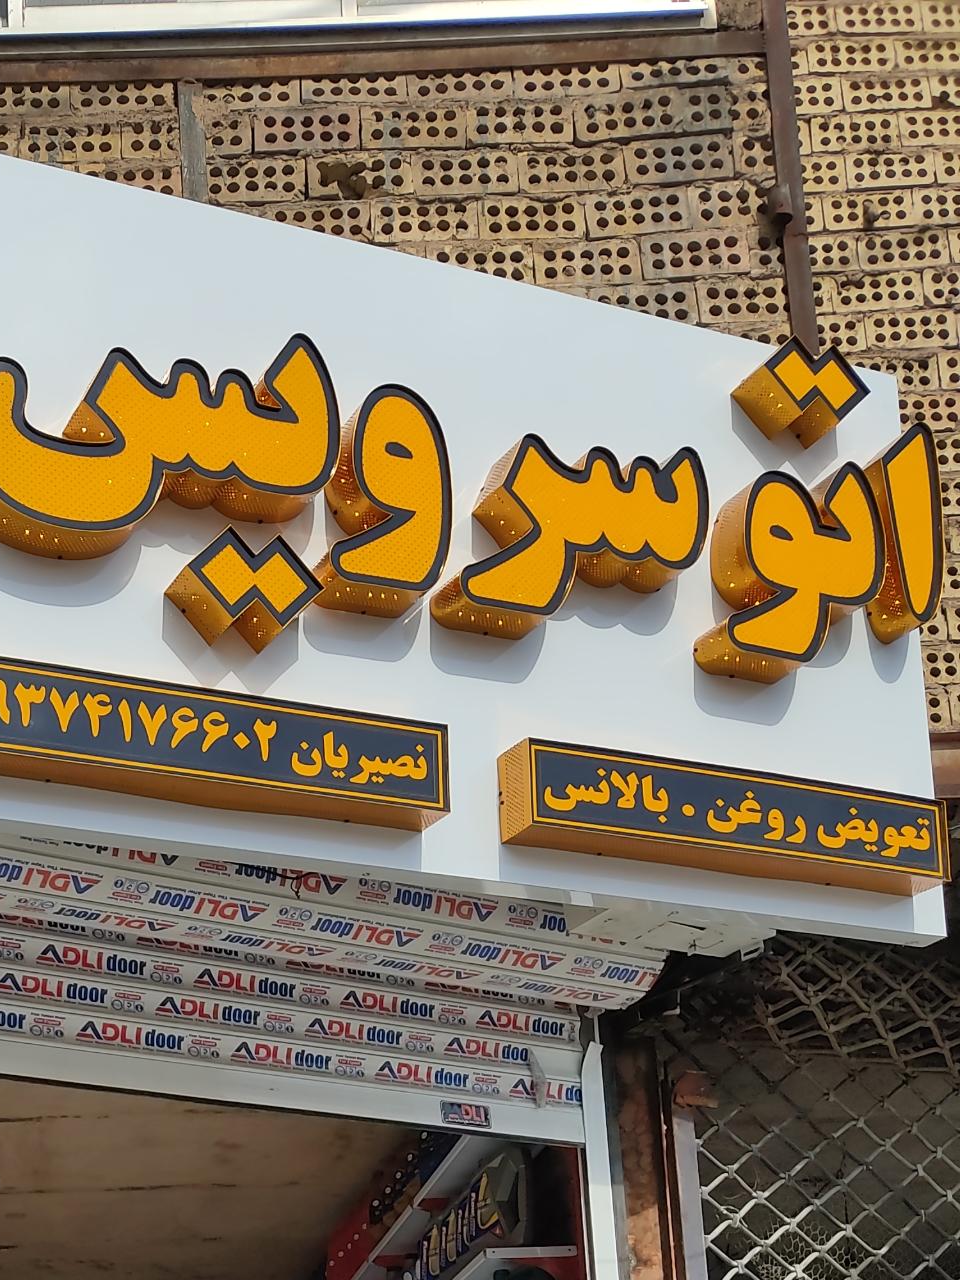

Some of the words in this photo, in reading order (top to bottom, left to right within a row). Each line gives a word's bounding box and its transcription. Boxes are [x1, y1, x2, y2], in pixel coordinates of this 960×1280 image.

[712, 335, 942, 675] اتو
[543, 767, 670, 824] بالانس
[706, 789, 807, 845] روغن
[816, 806, 932, 858] تعویض
[22, 868, 104, 895] ADLI
[149, 890, 194, 911] door
[194, 897, 270, 923] ADLI
[393, 888, 434, 911] door
[433, 896, 498, 922] ADLI
[100, 913, 176, 932] ADLI
[311, 917, 354, 939] door
[540, 912, 566, 932] oor
[221, 932, 265, 948] door
[266, 938, 337, 957] ADLI
[351, 923, 424, 948] ADLI
[35, 944, 103, 970] ADLI
[106, 954, 147, 975] door
[374, 957, 417, 972] door
[460, 942, 500, 963] door
[499, 948, 567, 971] ADLI
[193, 968, 256, 993] ADLI
[258, 977, 297, 998] door
[416, 962, 484, 981] ADLI
[600, 964, 639, 984] door
[67, 982, 107, 1004] door
[518, 980, 558, 994] door
[556, 985, 619, 1003] ADLI
[155, 996, 219, 1019] ADLI
[222, 1004, 260, 1025] door
[339, 990, 398, 1013] ADLI
[399, 999, 435, 1018] door
[75, 1021, 141, 1045] ADLI
[145, 1030, 184, 1050] door
[304, 1018, 364, 1039] ADLI
[366, 1024, 402, 1045] door
[476, 1009, 530, 1032] ADLI
[532, 1016, 565, 1037] door
[230, 1042, 292, 1065] ADLI
[295, 1050, 333, 1070] door
[444, 1037, 500, 1060] ADLI
[502, 1045, 529, 1066] doo
[374, 1061, 432, 1085] ADLI
[434, 1068, 469, 1088] door
[565, 1085, 582, 1104] do
